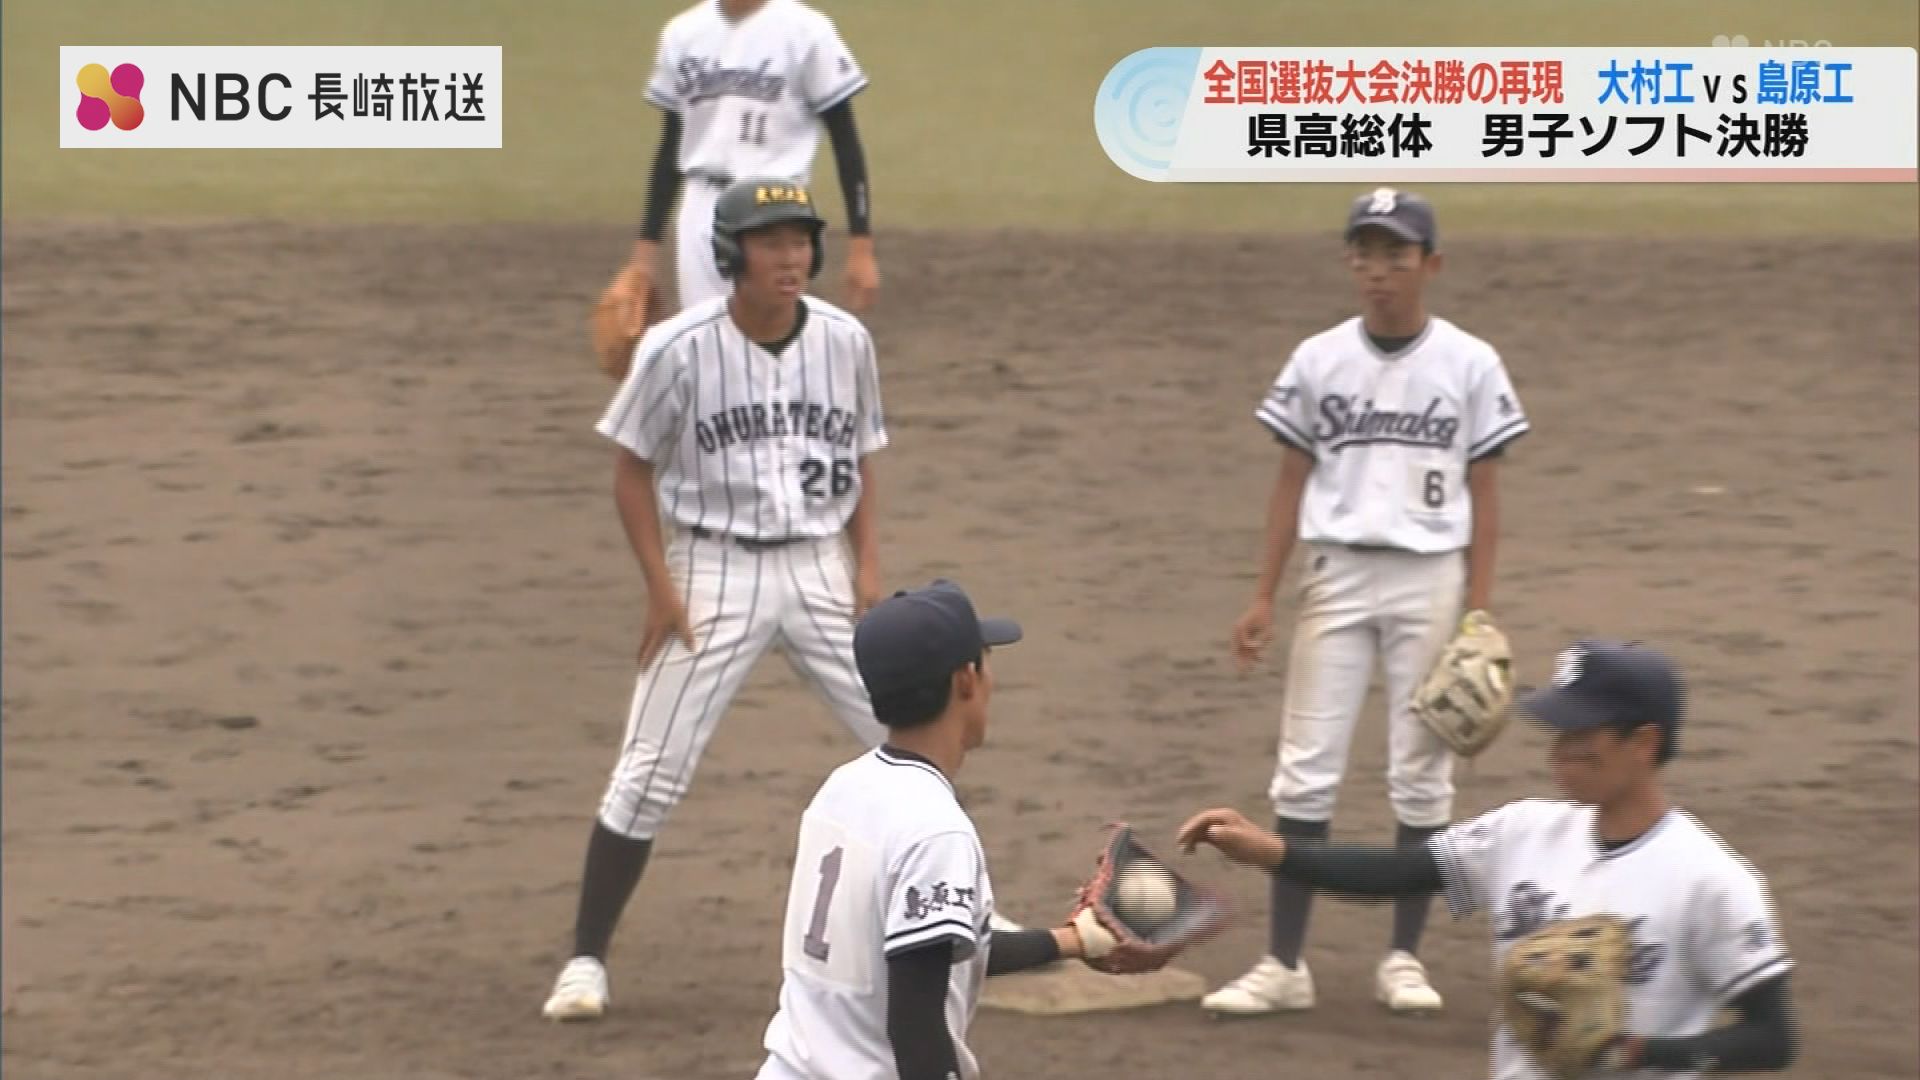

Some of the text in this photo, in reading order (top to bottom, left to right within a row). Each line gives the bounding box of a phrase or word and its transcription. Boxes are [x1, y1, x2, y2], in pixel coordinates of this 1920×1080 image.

[738, 111, 768, 144] 11
[800, 459, 855, 497] 26
[1423, 470, 1445, 508] 6
[803, 845, 843, 962] 1
